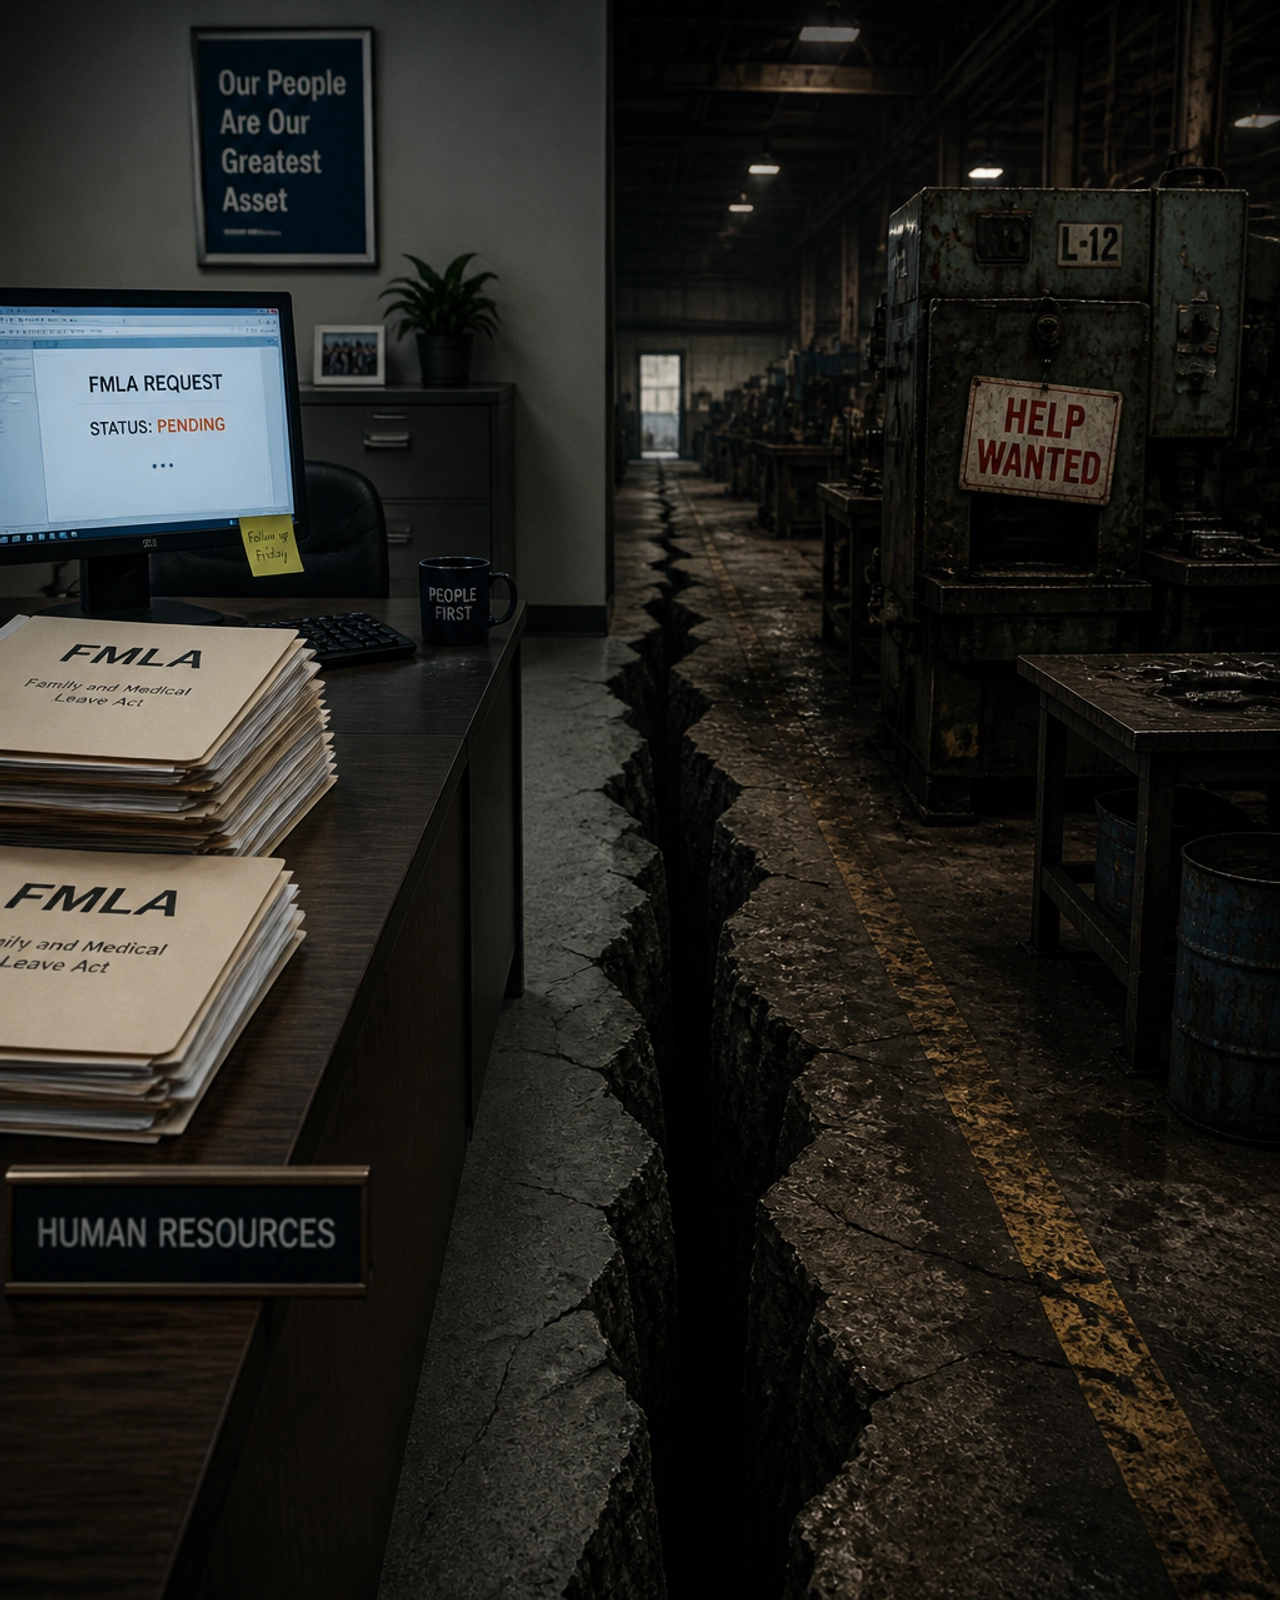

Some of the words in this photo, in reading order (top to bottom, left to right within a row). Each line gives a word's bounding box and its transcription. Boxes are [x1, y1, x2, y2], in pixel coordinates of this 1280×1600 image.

[218, 68, 261, 96] Our
[267, 68, 347, 102] People
[219, 107, 261, 135] Are
[267, 107, 311, 135] Our
[221, 147, 323, 174] Greatest
[222, 186, 288, 213] Asset
[1062, 226, 1118, 261] L-12
[89, 375, 139, 393] FMLA
[144, 374, 222, 393] REQUEST
[90, 420, 152, 436] STATUS:
[157, 417, 225, 433] PENDING
[1004, 397, 1085, 439] HELP
[978, 438, 1101, 485] WANTED
[428, 586, 477, 603] PEOPLE
[435, 605, 472, 621] FIRST
[59, 643, 202, 669] FMLA
[24, 678, 83, 692] Family
[86, 684, 120, 693] and
[122, 684, 192, 697] Medical
[54, 693, 108, 706] Leave
[112, 697, 144, 708] Act
[4, 883, 178, 917] FMLA
[36, 939, 80, 952] and
[81, 941, 168, 956] Medical
[0, 955, 65, 972] Leave
[70, 959, 111, 974] Act
[37, 1216, 147, 1249] HUMAN
[158, 1216, 337, 1249] RESOURCES
